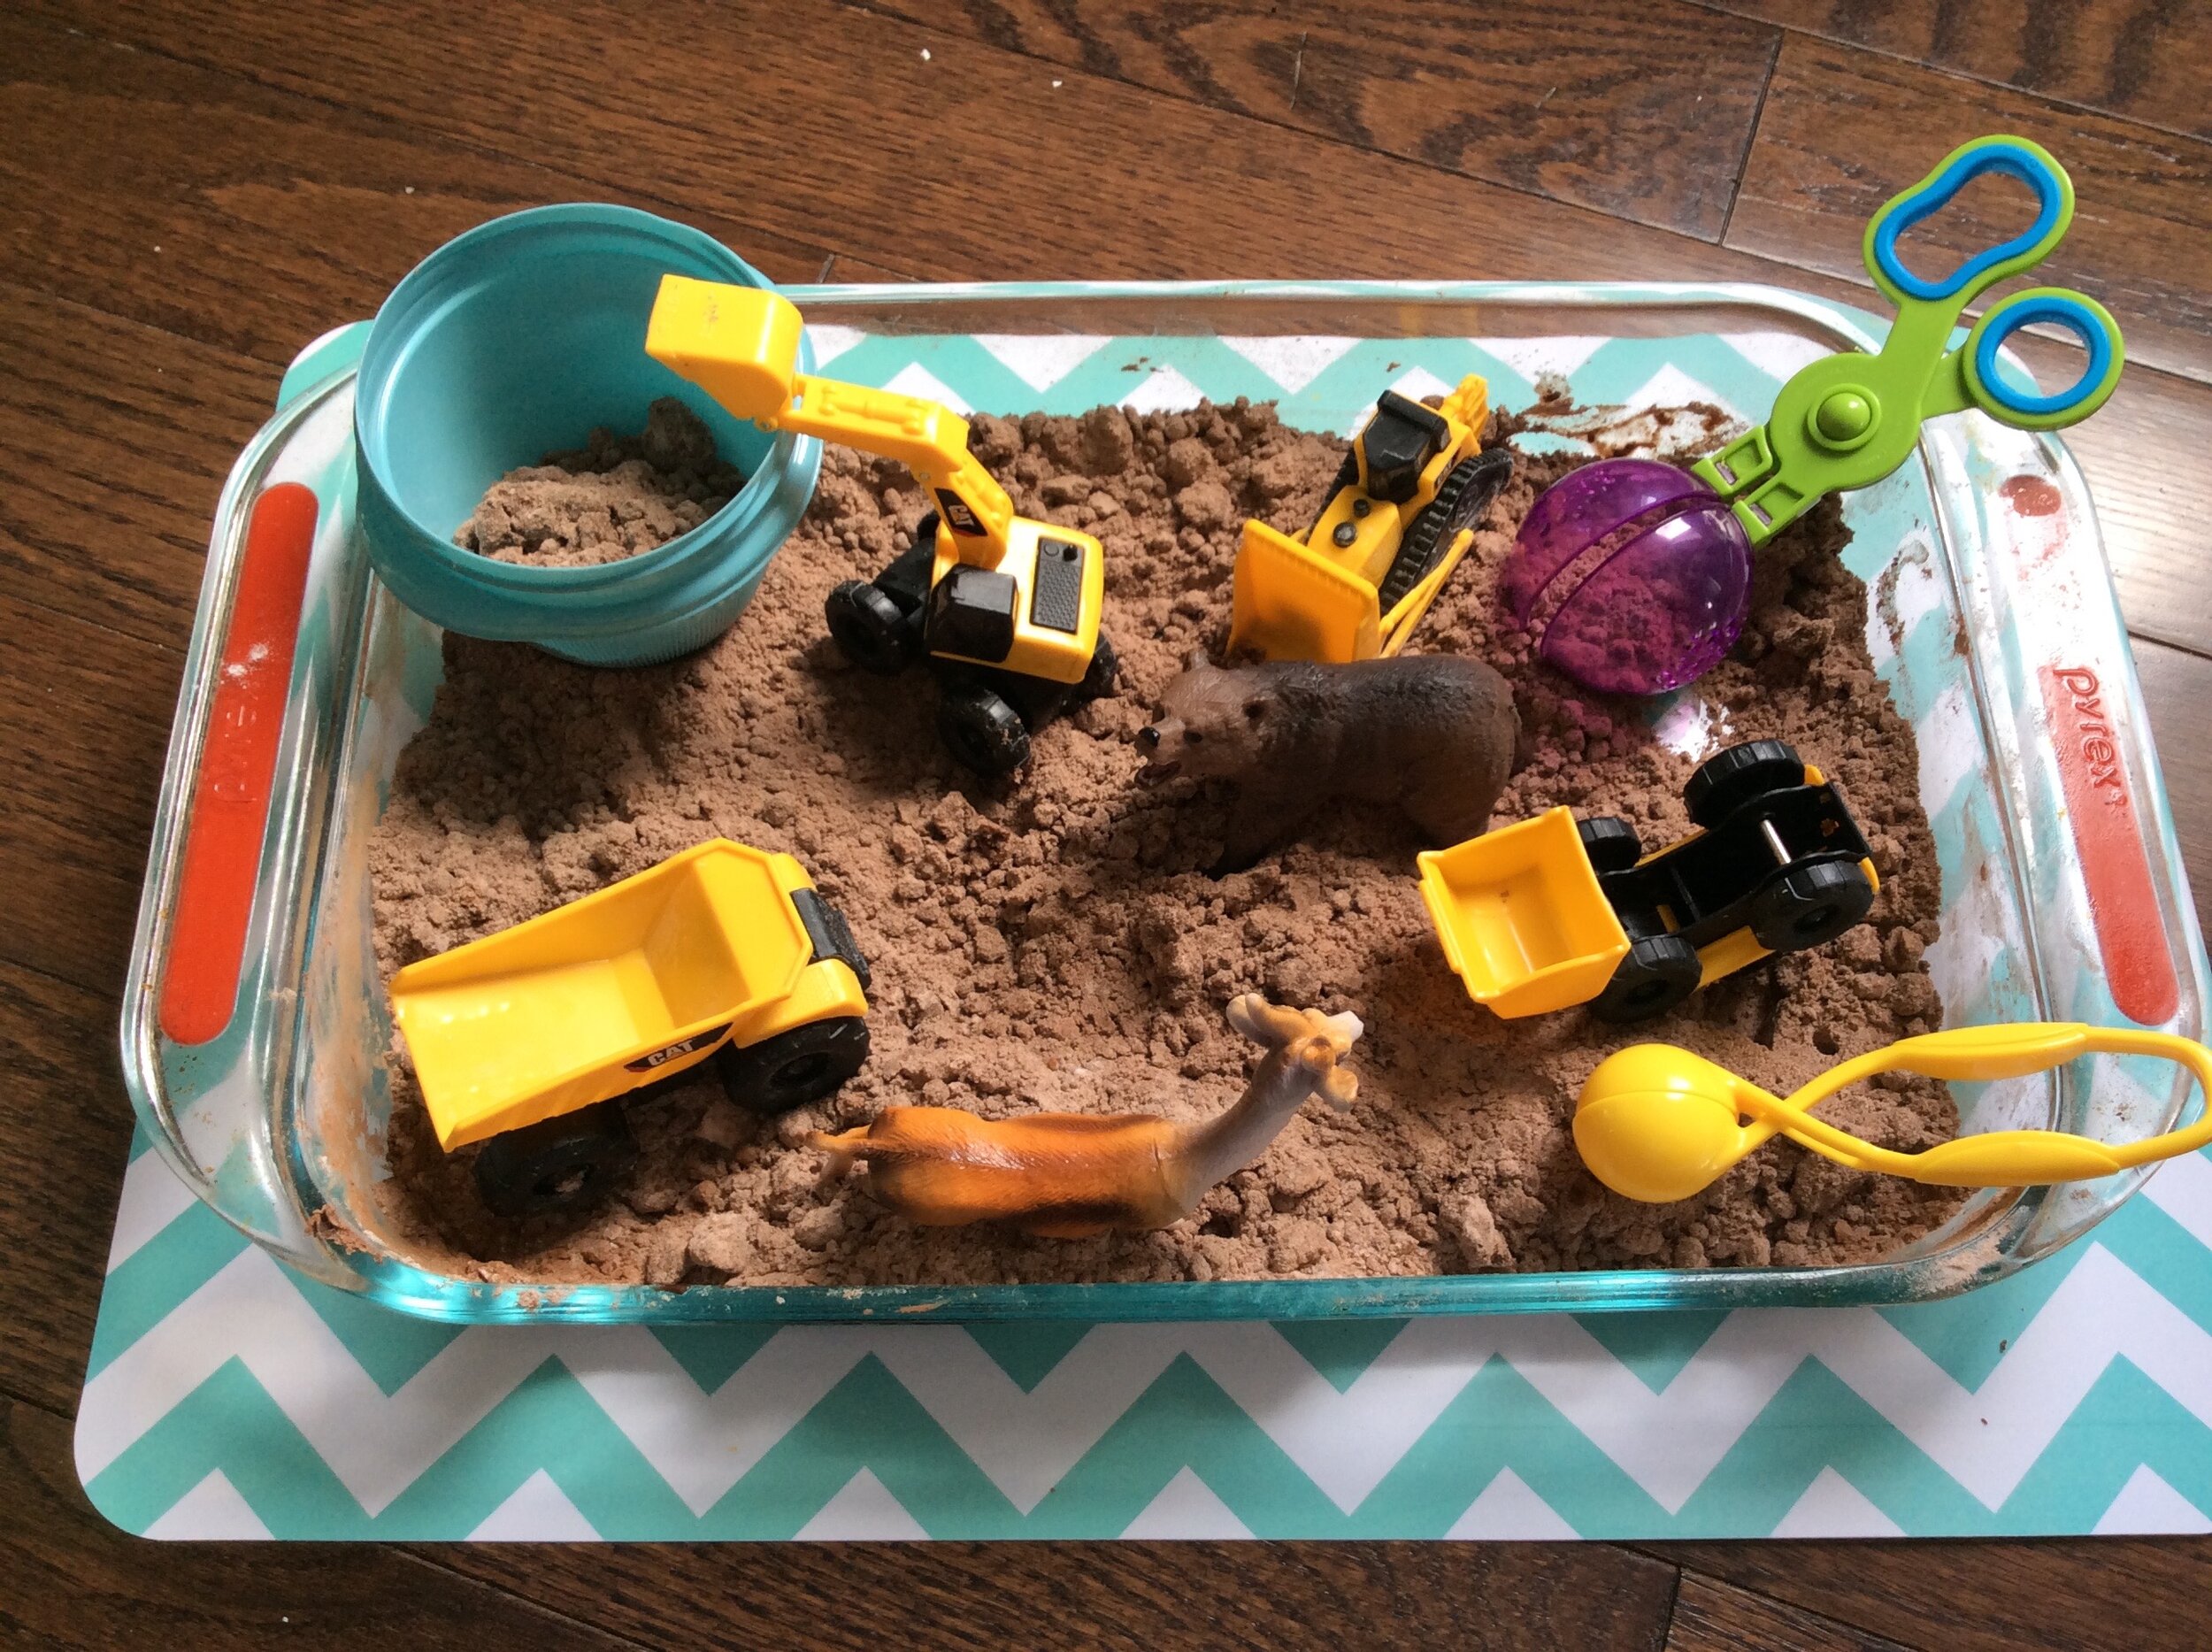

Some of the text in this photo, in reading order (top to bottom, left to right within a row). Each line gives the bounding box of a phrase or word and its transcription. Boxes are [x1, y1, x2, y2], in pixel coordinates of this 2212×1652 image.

[948, 504, 976, 526] CAT
[212, 683, 260, 803] pre
[2052, 667, 2122, 788] pyrex
[647, 1039, 695, 1067] CAT
